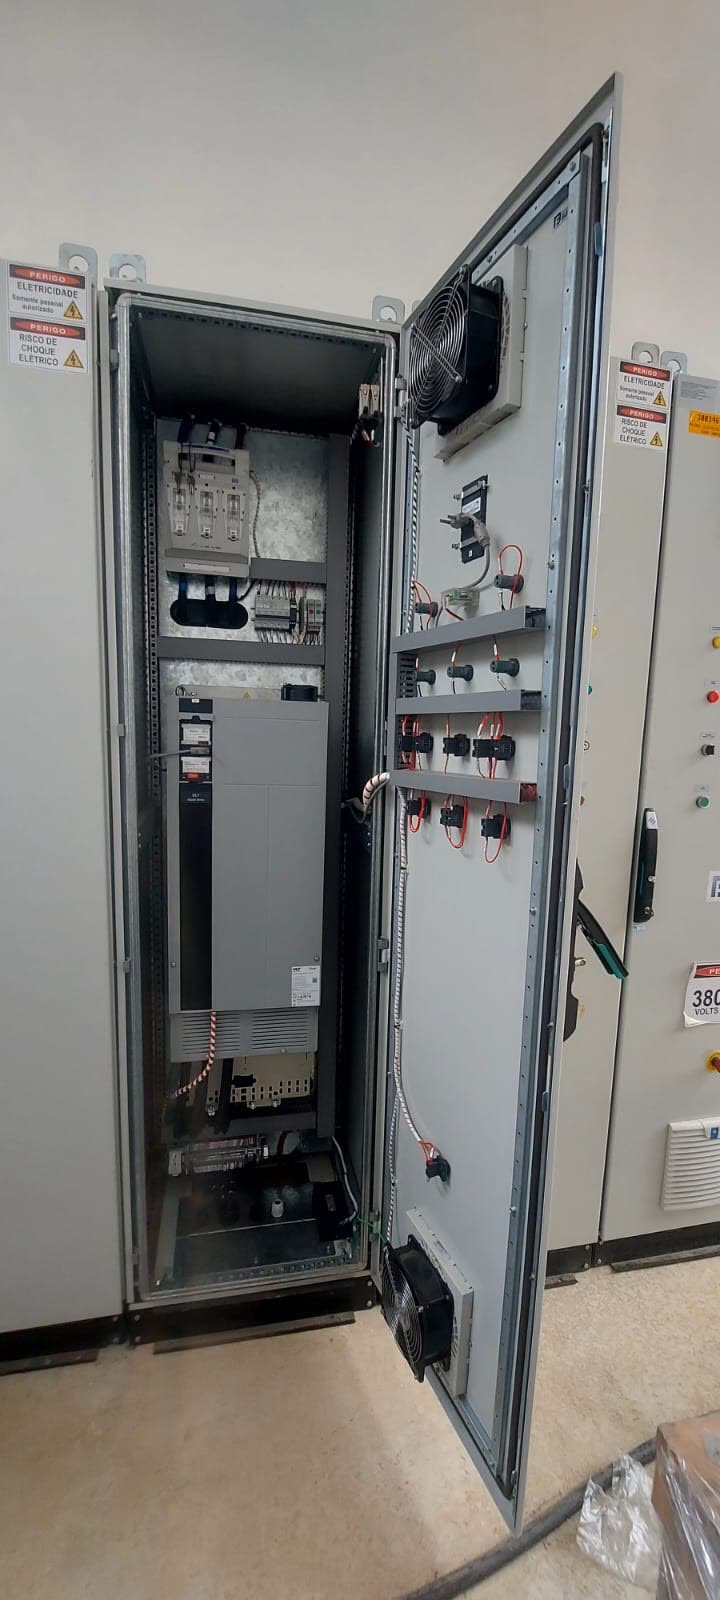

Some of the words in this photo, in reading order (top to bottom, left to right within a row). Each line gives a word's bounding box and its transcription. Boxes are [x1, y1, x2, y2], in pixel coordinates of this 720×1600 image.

[29, 271, 66, 283] PERIGO
[17, 281, 79, 299] ELETRICIDADE
[12, 293, 38, 304] Somente
[40, 299, 63, 308] pessoal
[22, 304, 54, 314] autorizado
[30, 323, 66, 335] PERIGO
[19, 334, 44, 344] RISCO
[46, 337, 57, 346] DE
[21, 344, 56, 356] CHOQUE
[19, 353, 59, 366] ELÉTRICO
[633, 367, 658, 377] PERIGO
[624, 376, 665, 390] ELETRICIDADE
[629, 409, 654, 419] PERIGO
[621, 418, 639, 427] RISCO
[621, 427, 646, 437] CHOQUE
[695, 1007, 719, 1016] VOLTS
